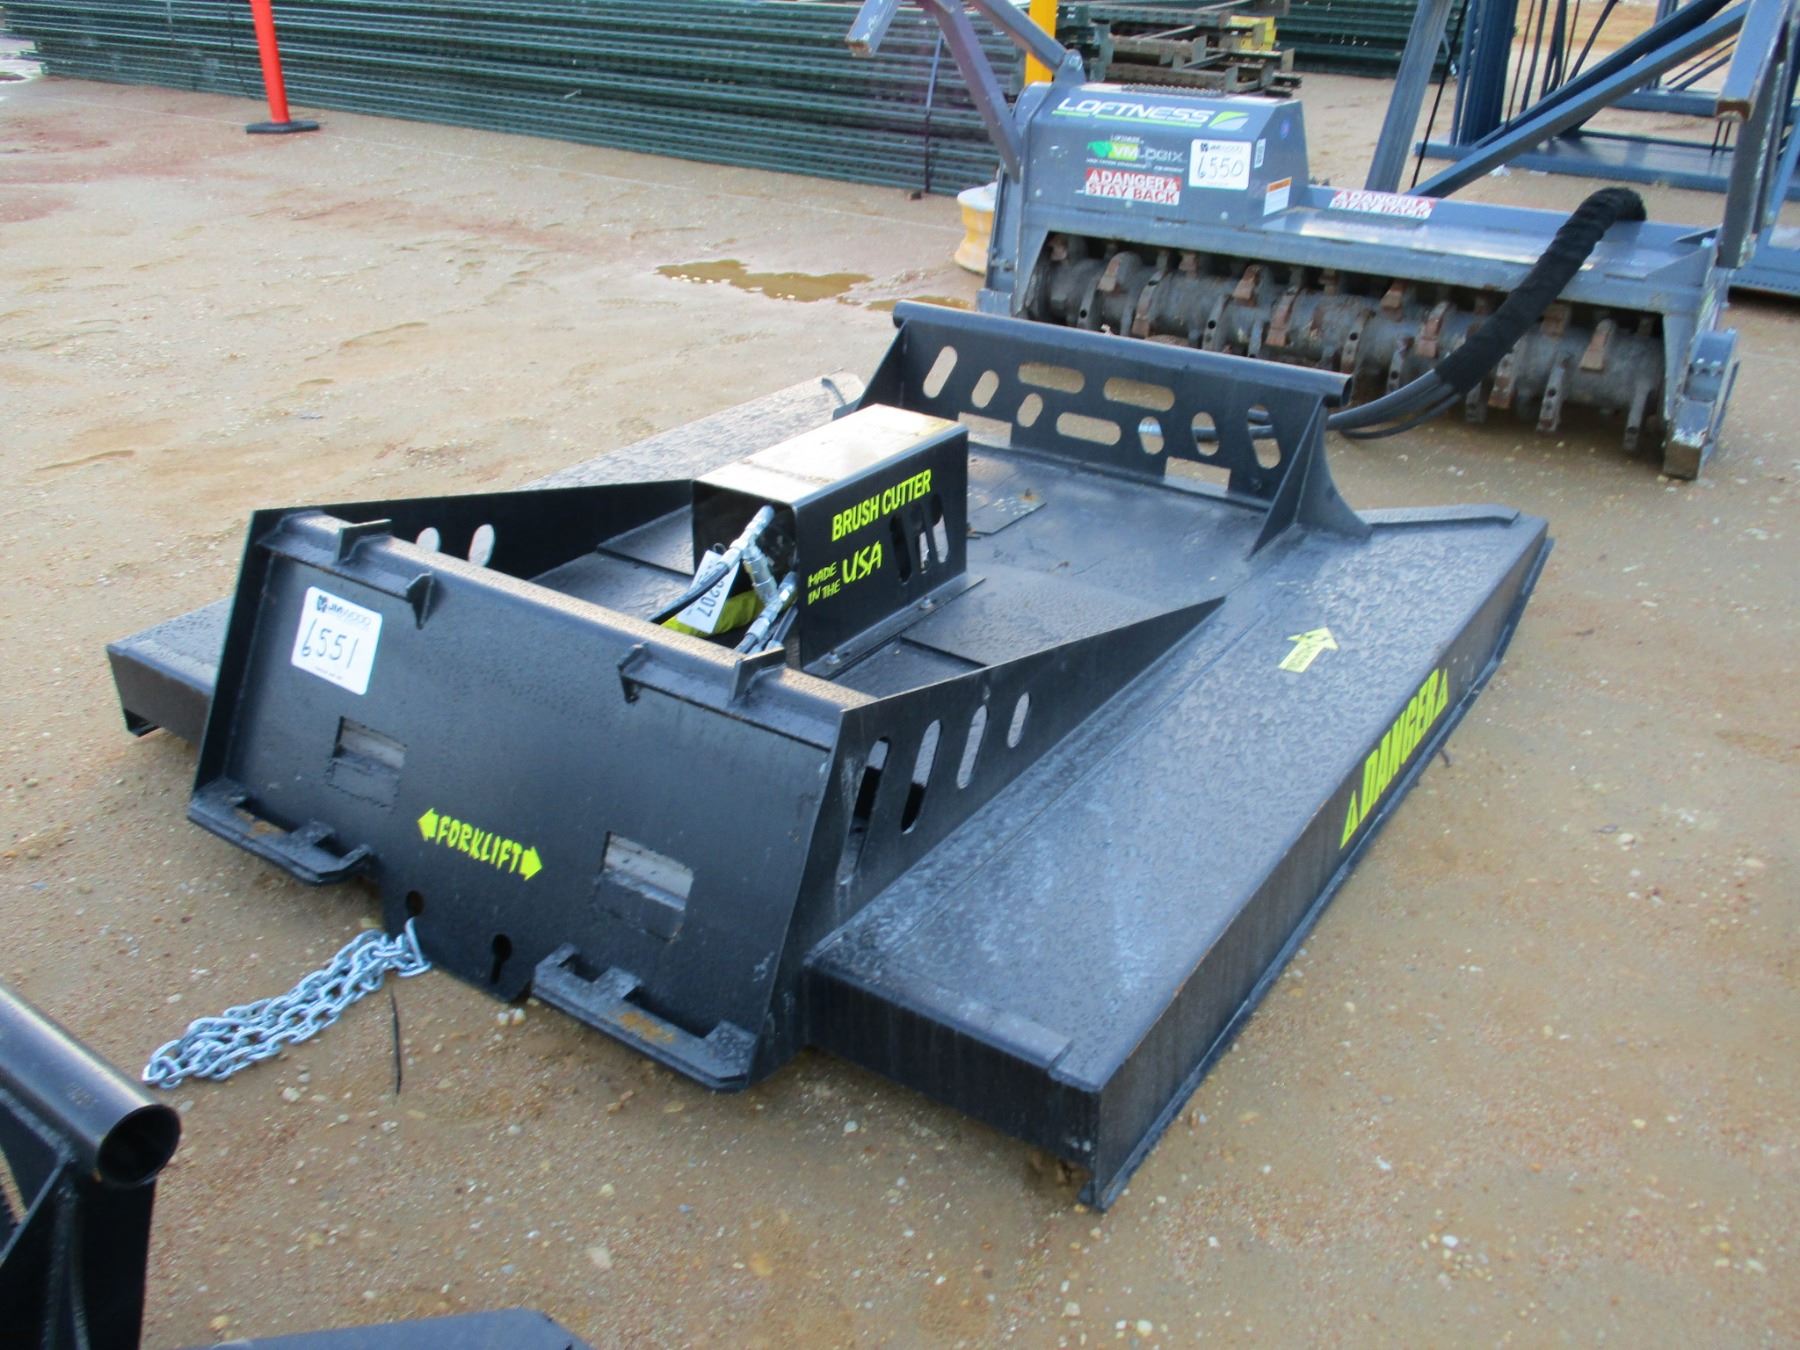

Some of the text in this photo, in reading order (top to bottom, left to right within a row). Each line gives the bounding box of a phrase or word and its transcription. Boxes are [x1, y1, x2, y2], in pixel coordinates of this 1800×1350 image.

[1056, 97, 1217, 123] LOFTNESS
[1100, 170, 1165, 188] DANGER
[1197, 155, 1245, 179] 6550
[1088, 182, 1177, 204] STAY BACK
[1349, 190, 1416, 206] DANGER
[832, 469, 931, 541] BRUSH CUTTER
[808, 561, 838, 588] MADE
[842, 540, 882, 584] USA
[808, 579, 841, 605] IN THE
[301, 617, 360, 669] 6551
[1359, 668, 1440, 824] DANGER
[435, 815, 523, 874] FORKLIFT
